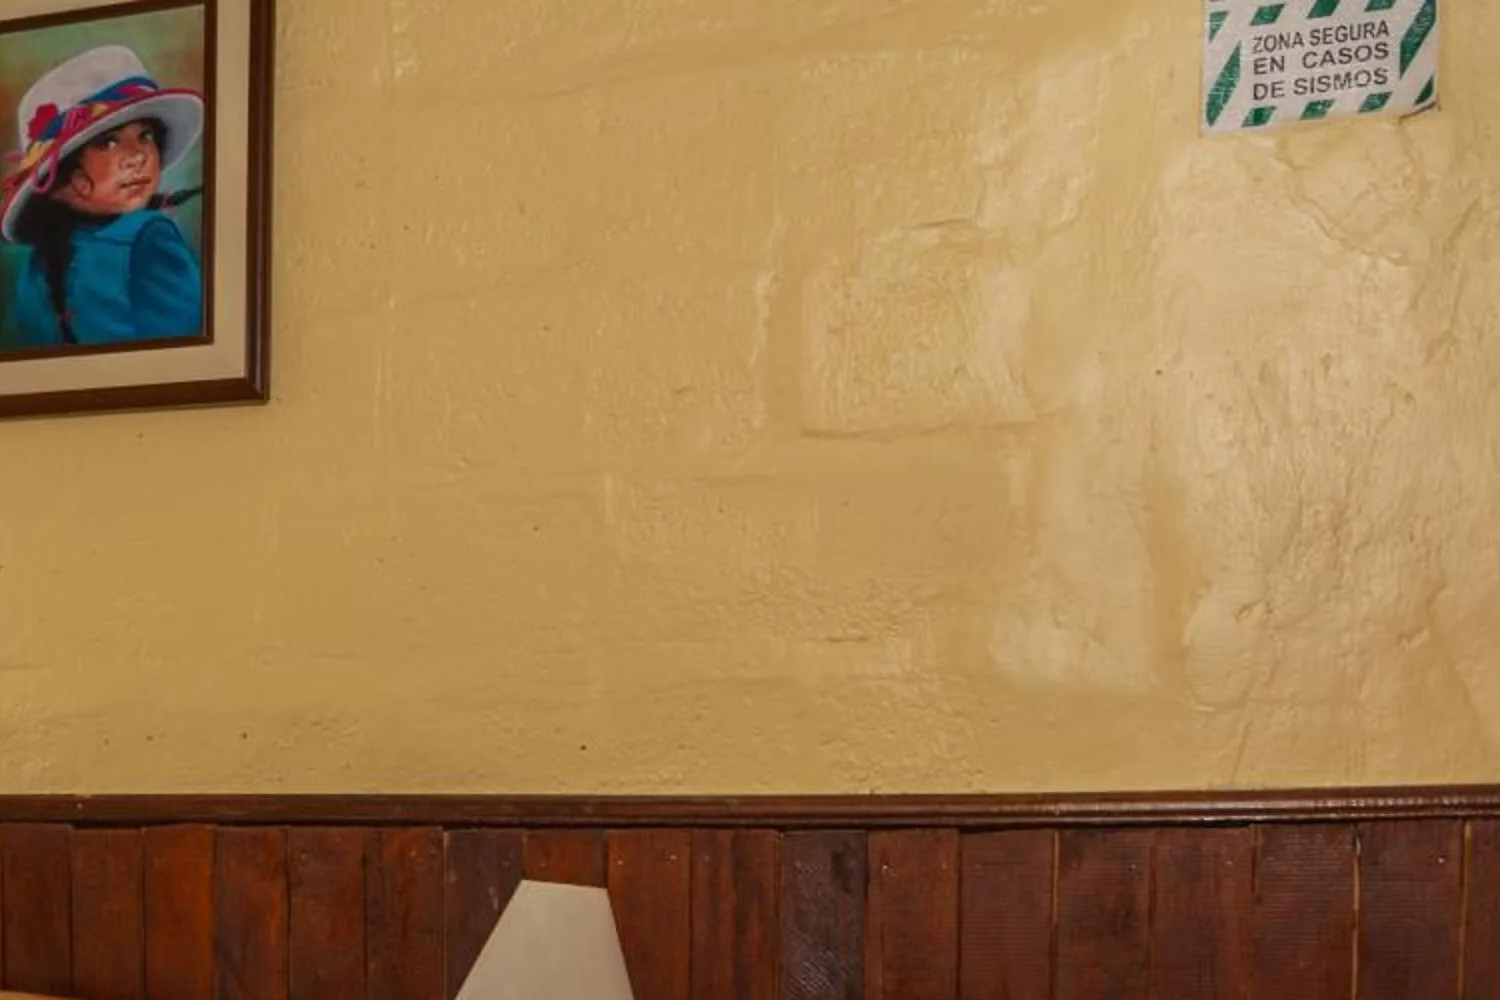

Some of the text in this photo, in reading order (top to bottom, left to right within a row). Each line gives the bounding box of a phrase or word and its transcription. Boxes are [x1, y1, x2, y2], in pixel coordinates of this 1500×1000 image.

[1252, 19, 1390, 54] ZONA SEGURA
[1253, 42, 1389, 75] EN CASOS
[1253, 67, 1388, 101] DE SISMOS
